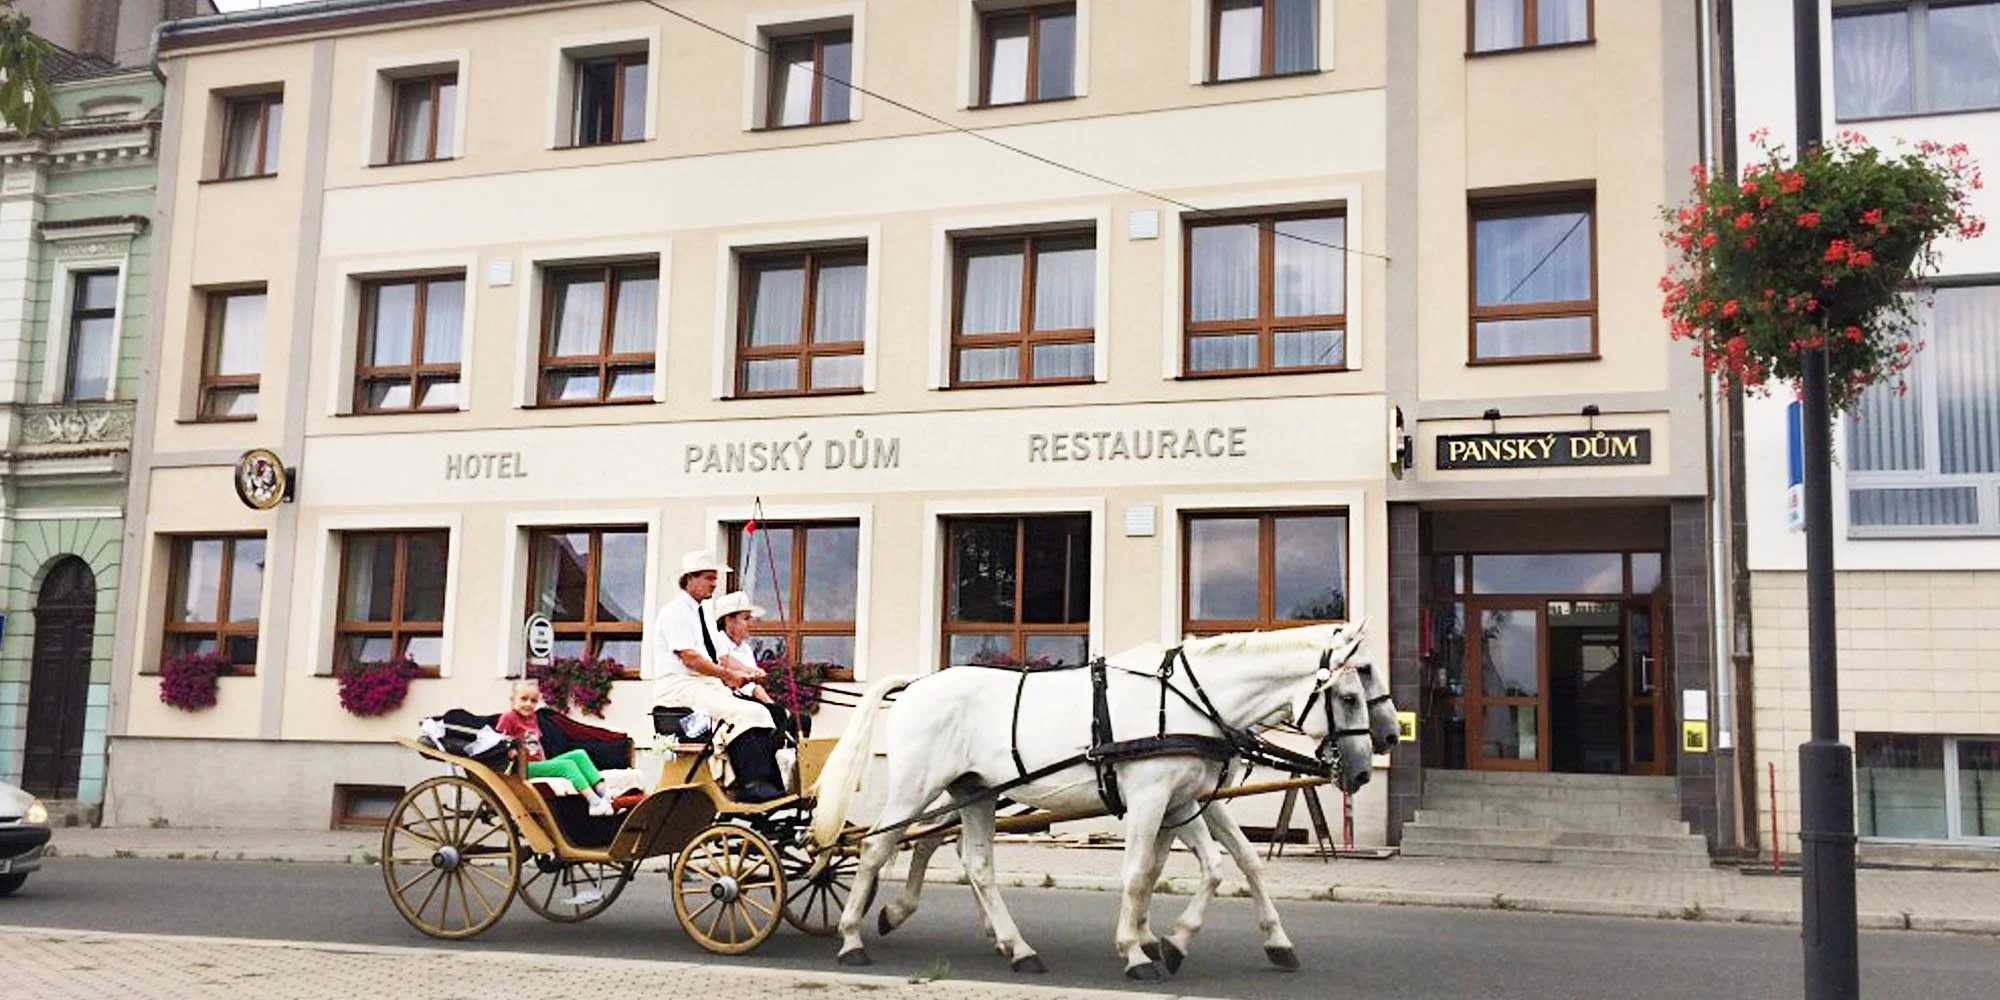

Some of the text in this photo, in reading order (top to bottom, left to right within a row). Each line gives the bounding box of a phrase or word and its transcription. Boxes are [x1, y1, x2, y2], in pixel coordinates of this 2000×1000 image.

[683, 428, 902, 475] PANSKÝ DŮM
[1027, 427, 1248, 464] RESTAURACE
[1448, 431, 1638, 461] PANSKÝ DŮM
[445, 451, 528, 481] HOTEL
